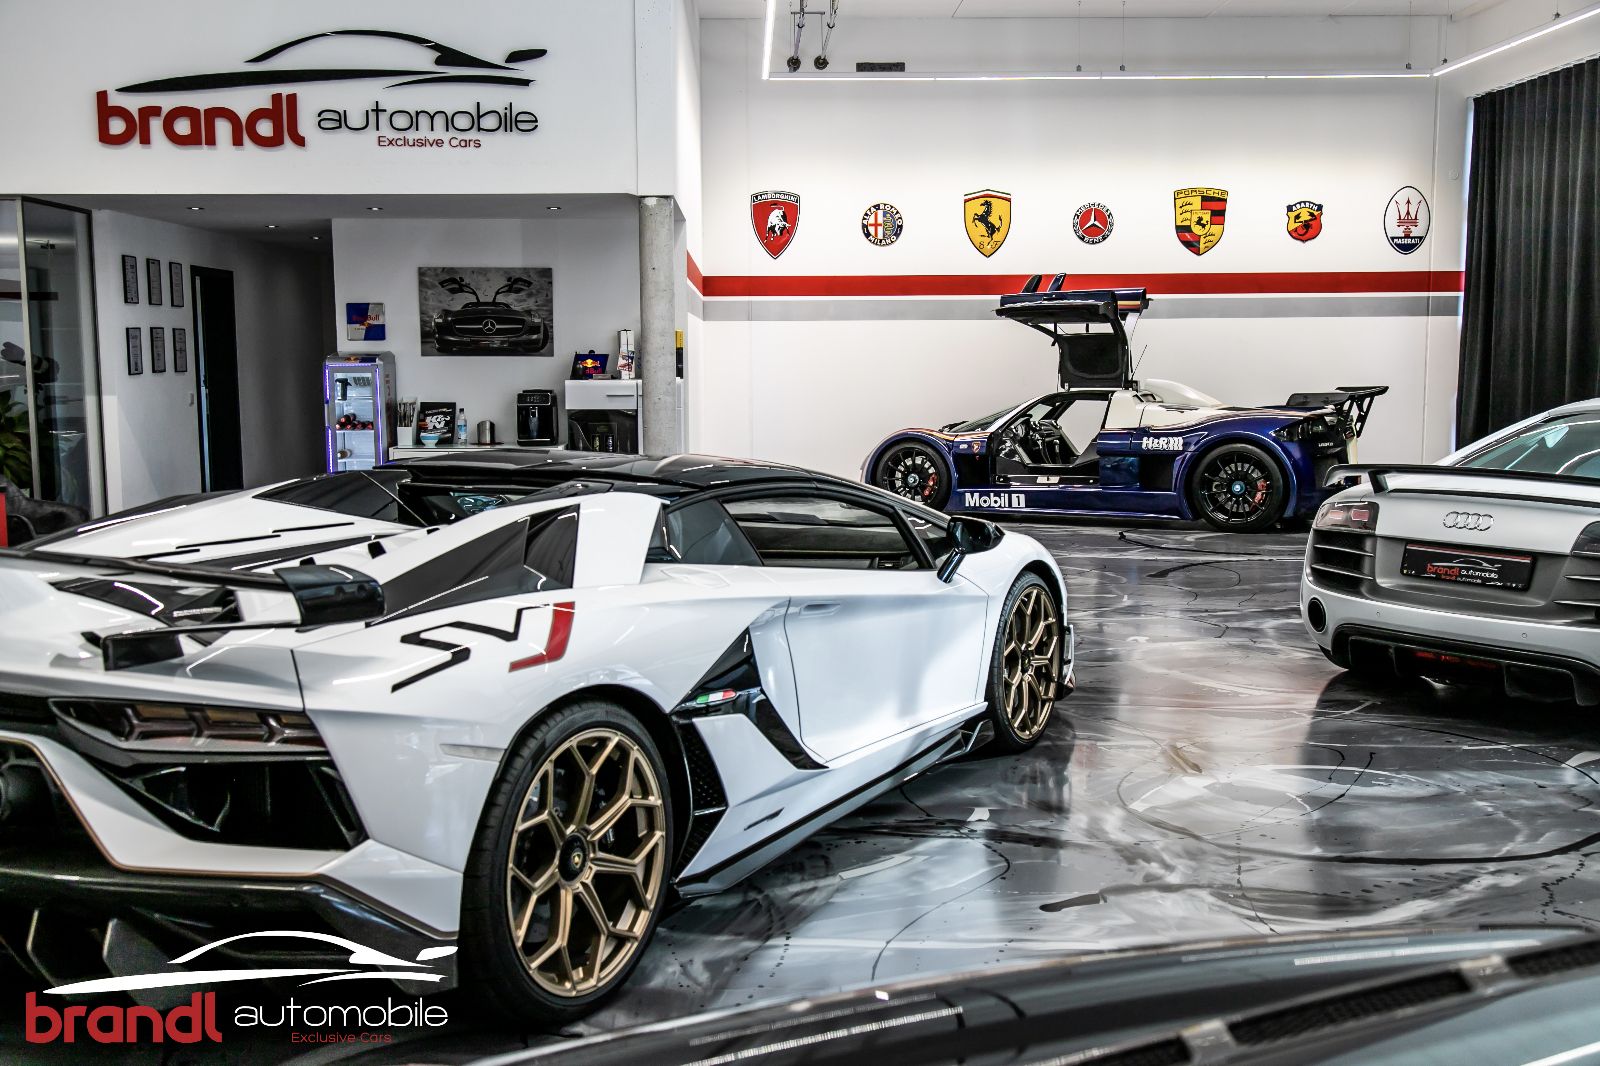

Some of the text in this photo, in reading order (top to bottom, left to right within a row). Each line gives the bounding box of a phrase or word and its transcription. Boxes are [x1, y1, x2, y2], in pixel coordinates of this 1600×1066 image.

[96, 90, 538, 148] brandl automobile
[377, 135, 482, 148] Exclusive Cars
[753, 193, 798, 202] LAMBORGHINI
[1176, 188, 1227, 198] PORSCHE
[1292, 203, 1318, 212] ABARTH
[868, 236, 897, 246] MILANO
[1142, 437, 1170, 451] H&R
[965, 492, 1009, 508] Mobil
[1426, 563, 1460, 576] brandl
[391, 601, 576, 692] SVJ
